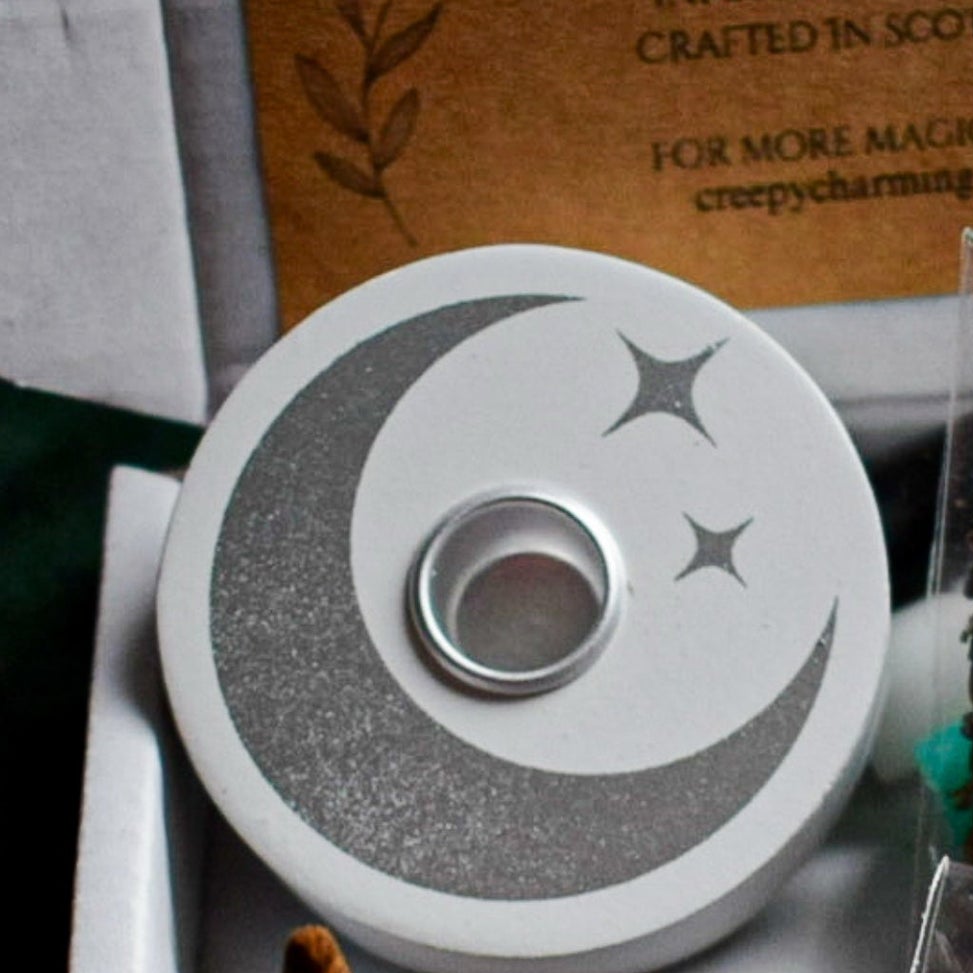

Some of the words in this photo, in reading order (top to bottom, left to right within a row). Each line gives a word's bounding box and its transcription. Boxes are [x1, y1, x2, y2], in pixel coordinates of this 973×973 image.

[637, 21, 818, 64] CRAFTED
[827, 17, 871, 50] IN
[651, 137, 732, 171] FOR
[743, 127, 850, 163] MORE
